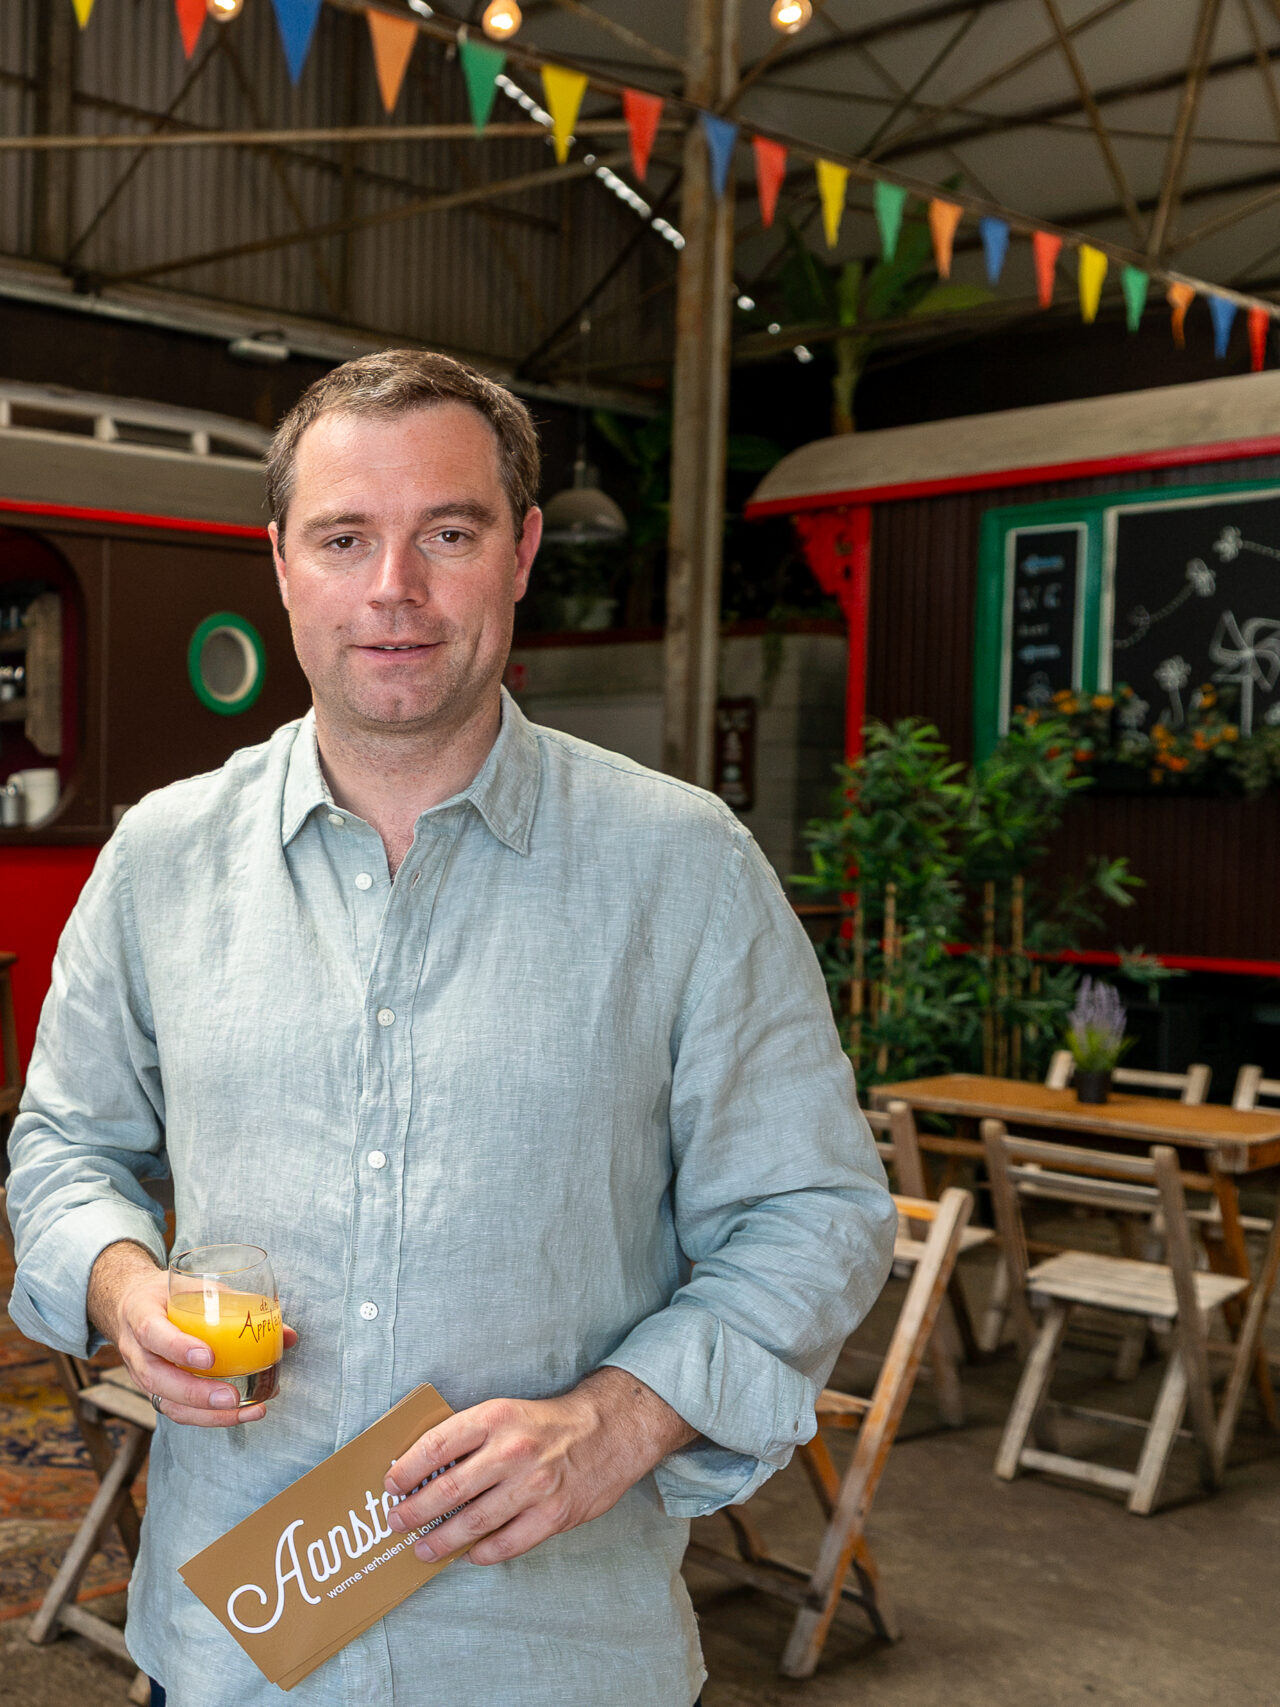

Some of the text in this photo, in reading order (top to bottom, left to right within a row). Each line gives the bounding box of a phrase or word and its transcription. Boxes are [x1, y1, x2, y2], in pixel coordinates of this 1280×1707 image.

[326, 1572, 363, 1599] warme
[361, 1542, 405, 1575] verhalen
[404, 1531, 420, 1546] uit
